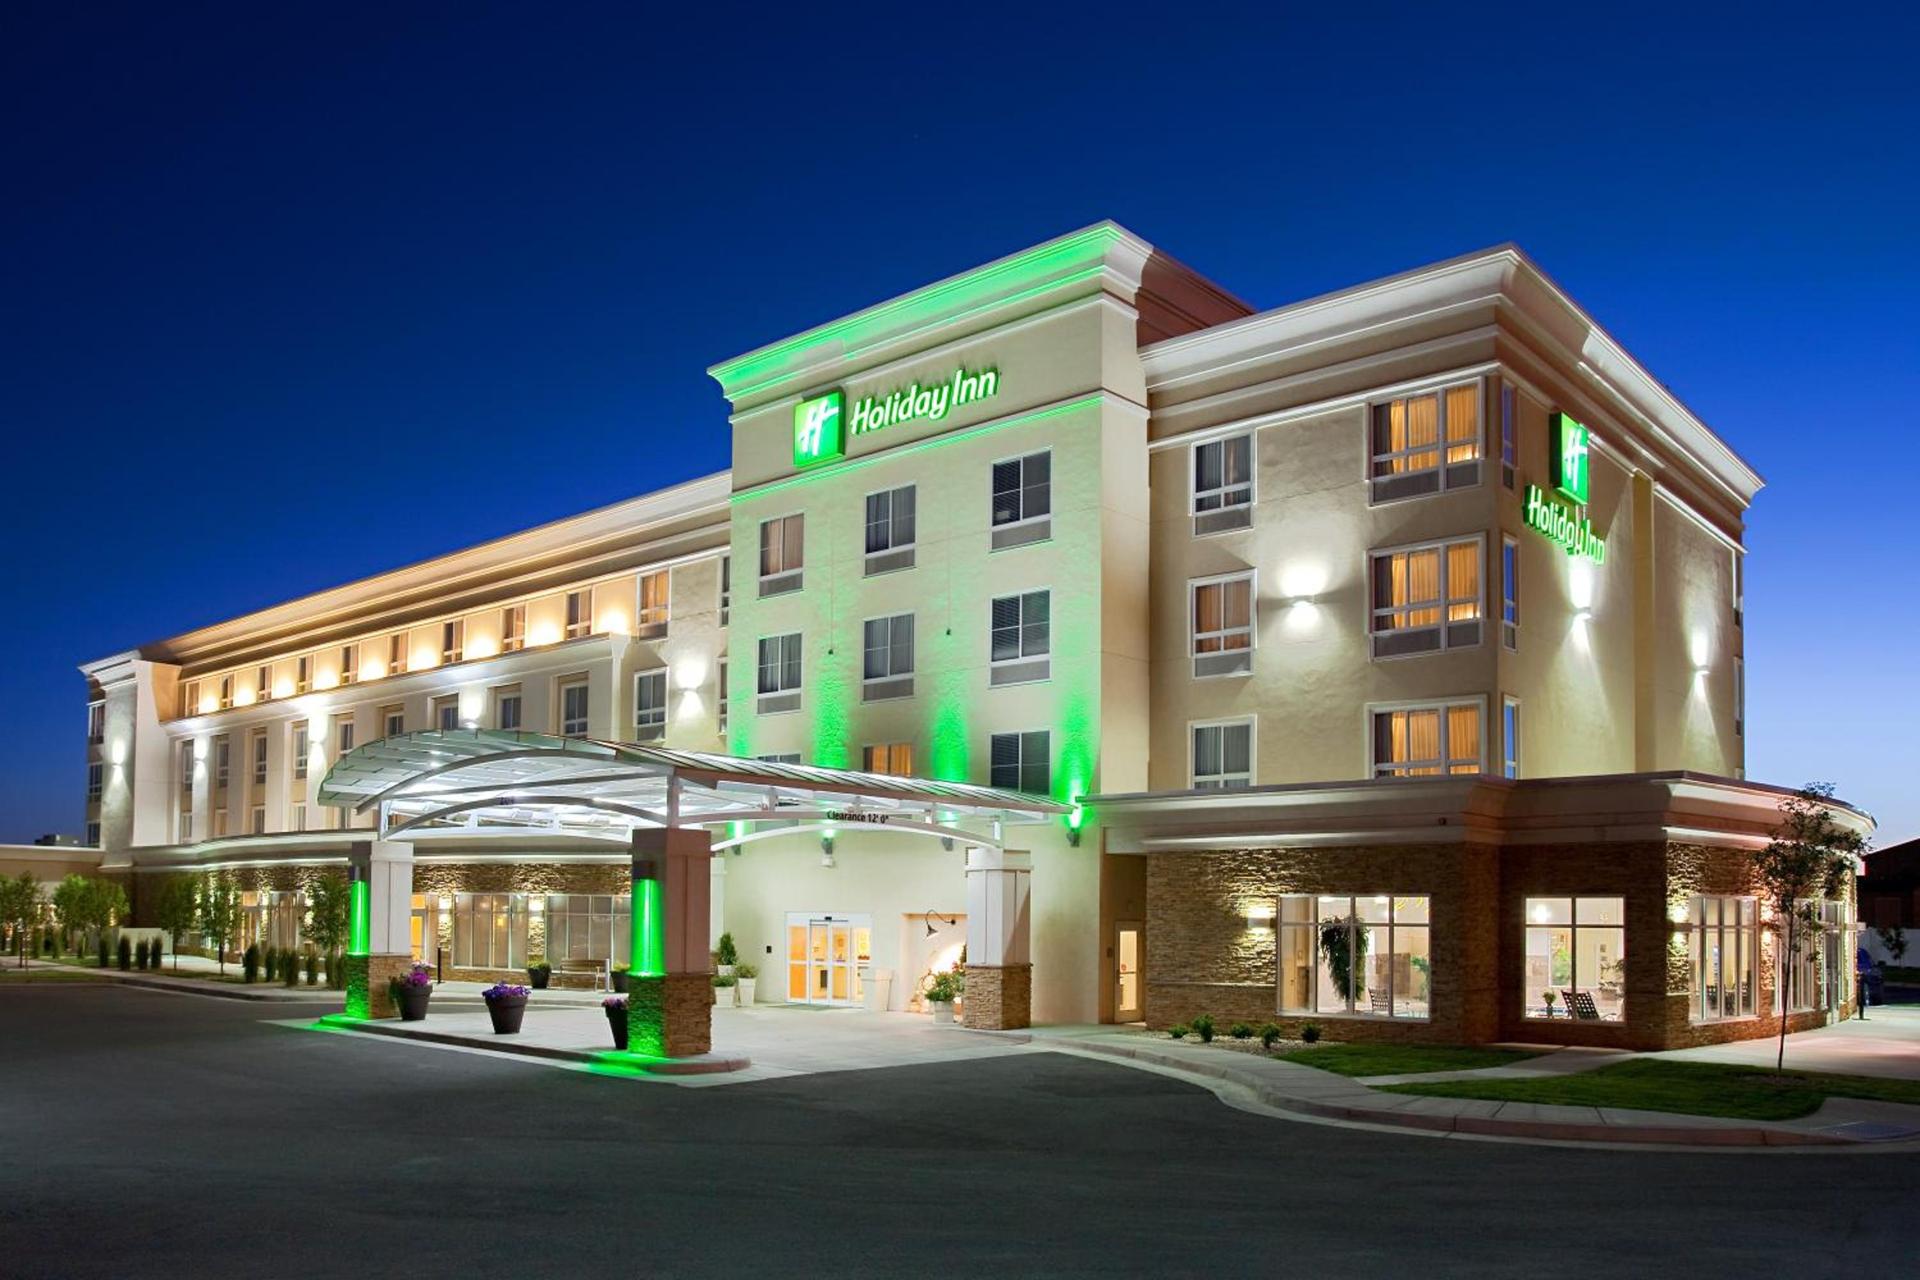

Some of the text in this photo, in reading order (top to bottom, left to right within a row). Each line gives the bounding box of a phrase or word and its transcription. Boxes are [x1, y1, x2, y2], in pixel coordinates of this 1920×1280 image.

[850, 369, 997, 434] Holiday Inn
[1528, 484, 1605, 565] Holiday Inn
[827, 810, 866, 822] Clearance
